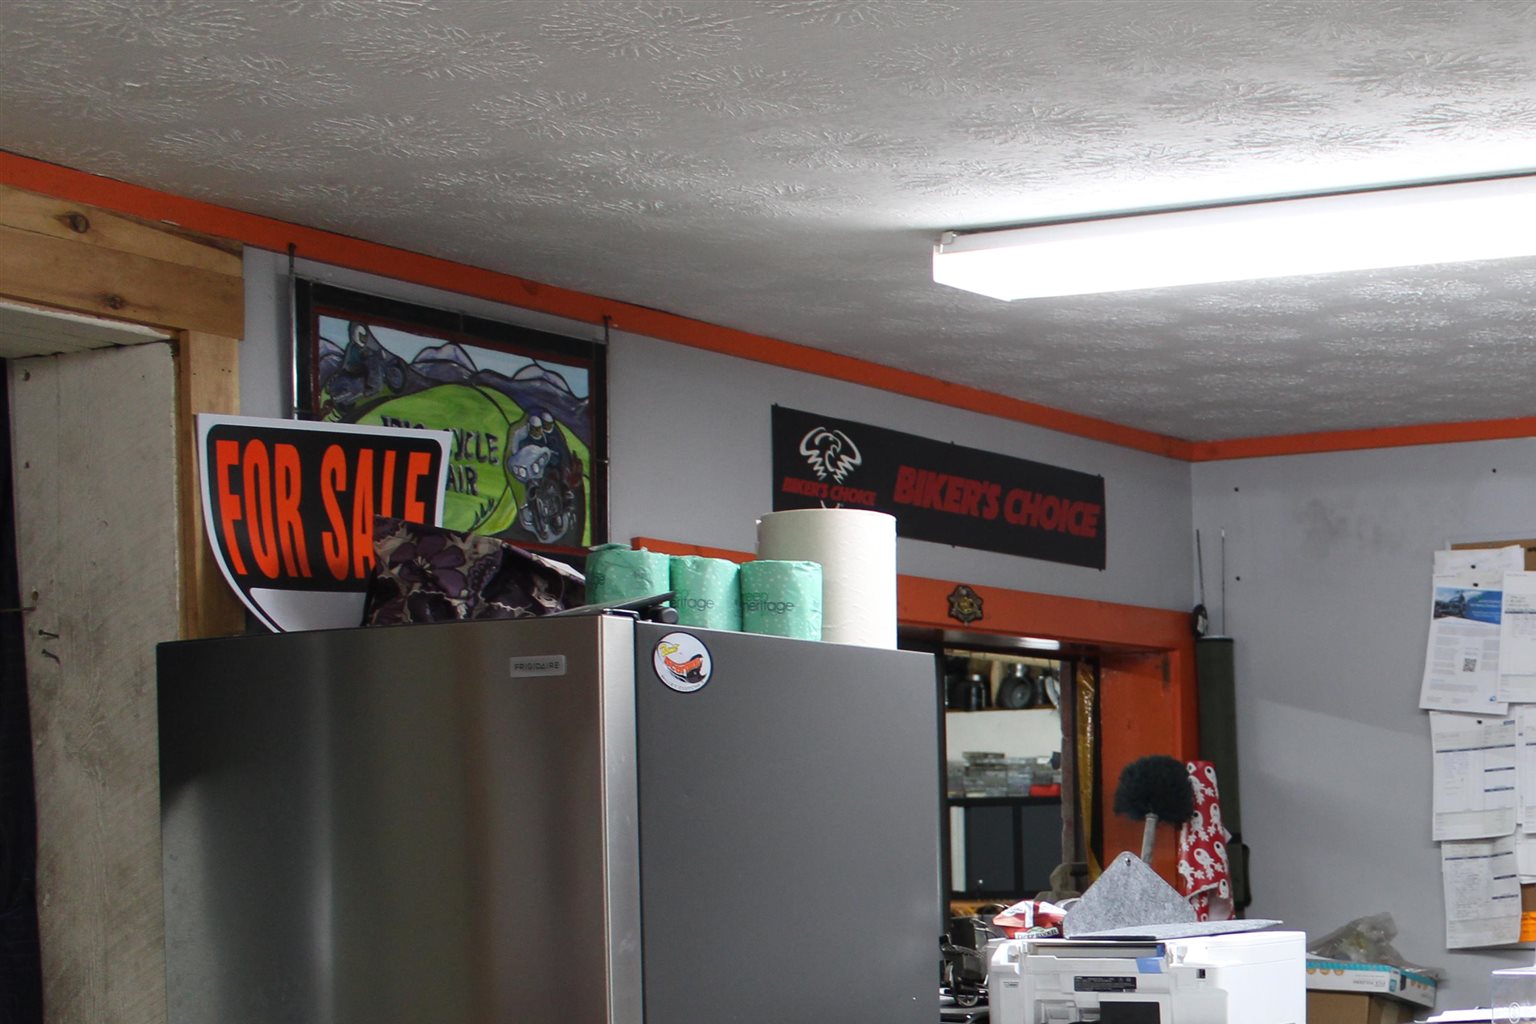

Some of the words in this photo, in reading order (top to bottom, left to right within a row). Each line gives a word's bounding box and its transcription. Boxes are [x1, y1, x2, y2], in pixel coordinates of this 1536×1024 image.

[444, 427, 498, 464] YCLE
[216, 439, 312, 579] FOR
[782, 477, 828, 499] BIKER'S
[830, 484, 877, 505] CHOICE
[894, 465, 1002, 520] BIKER'S
[1004, 488, 1101, 538] CHOICE
[514, 661, 560, 670] FRIGIDAIRE
